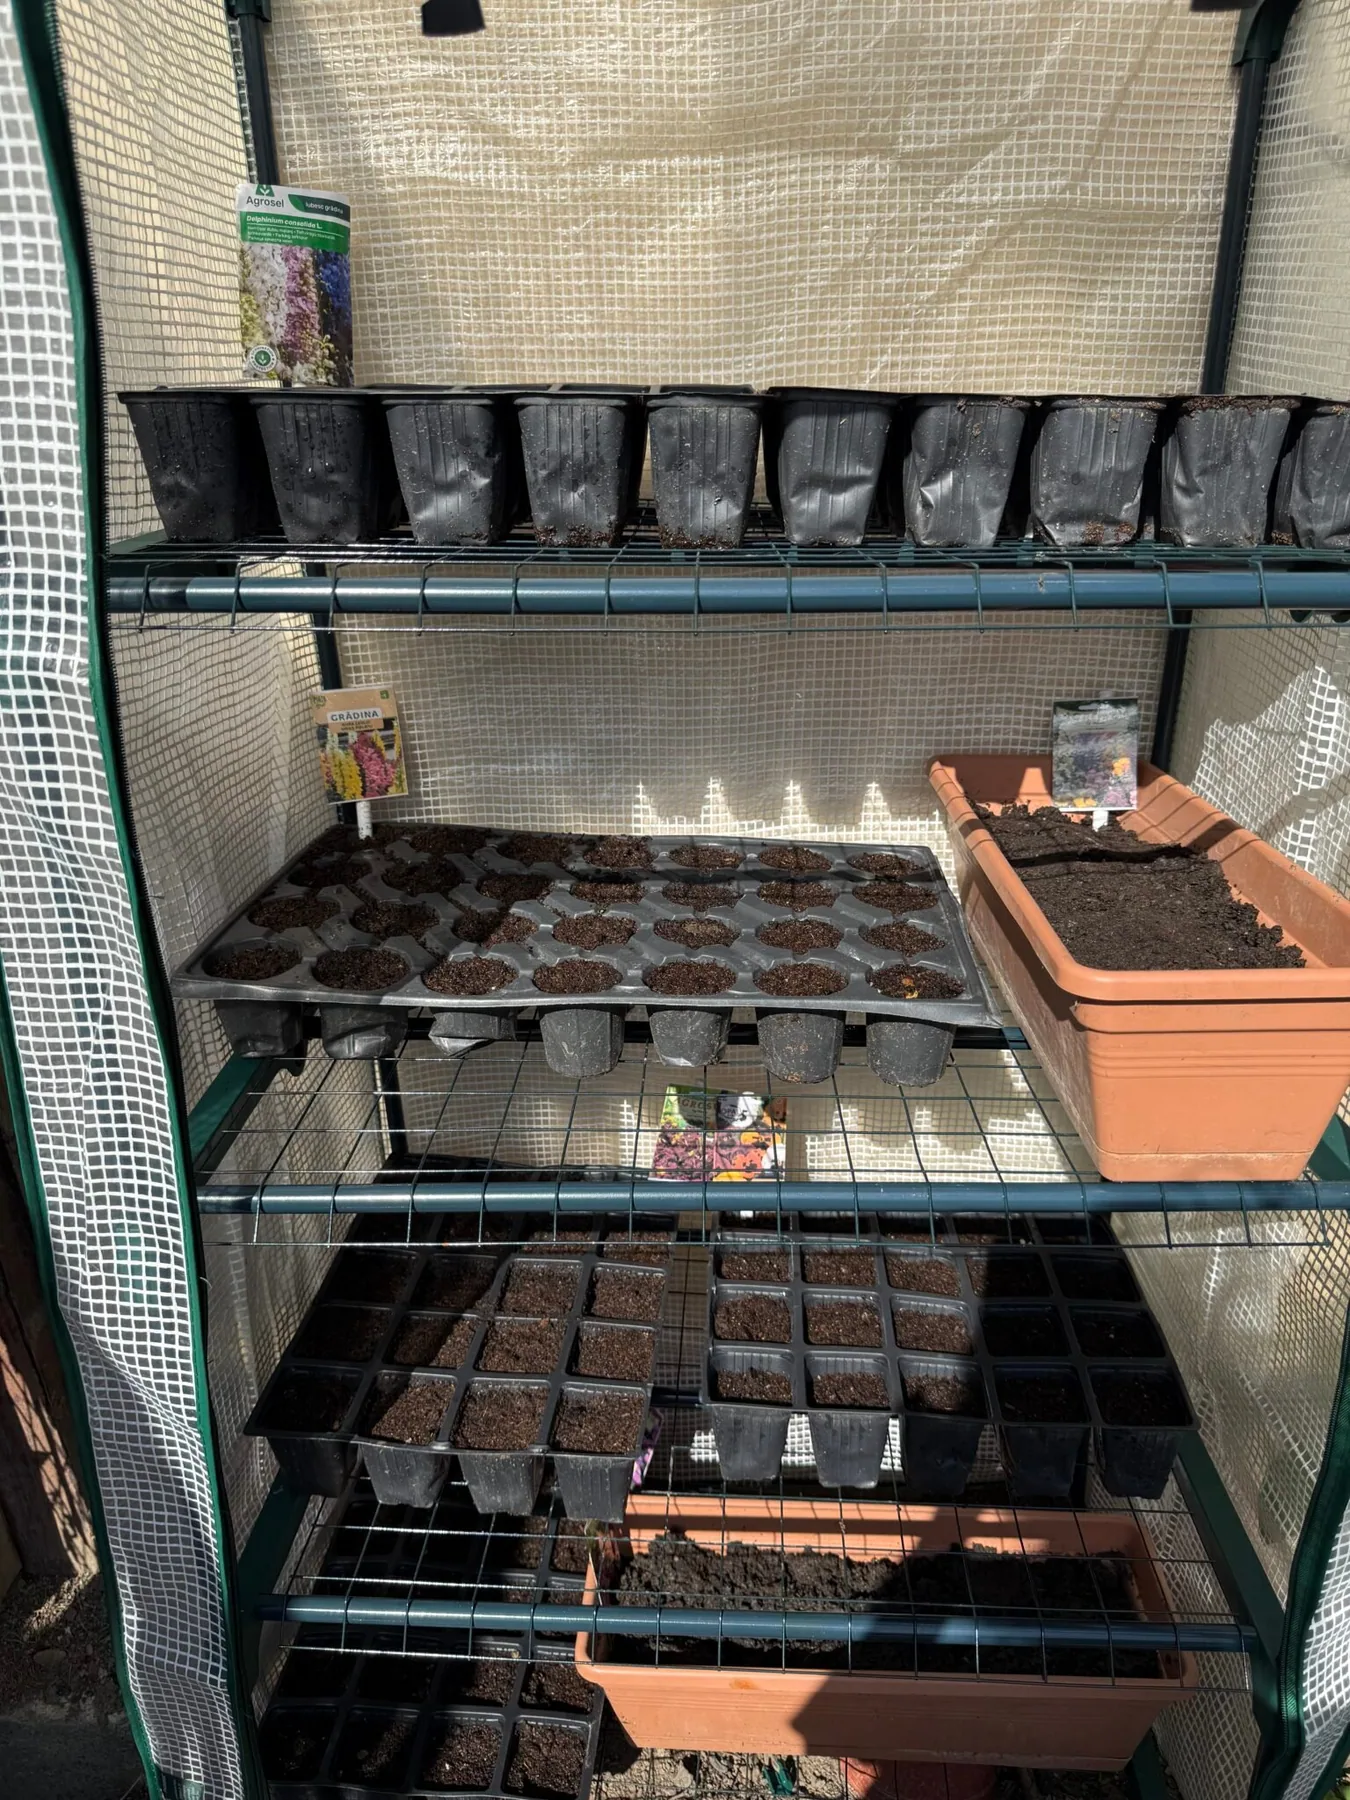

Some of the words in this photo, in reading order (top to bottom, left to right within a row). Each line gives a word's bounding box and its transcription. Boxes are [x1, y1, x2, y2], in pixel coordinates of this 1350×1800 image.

[246, 196, 284, 208] Agrosel
[246, 215, 283, 225] Delphinium
[331, 710, 379, 721] GRĂDINA
